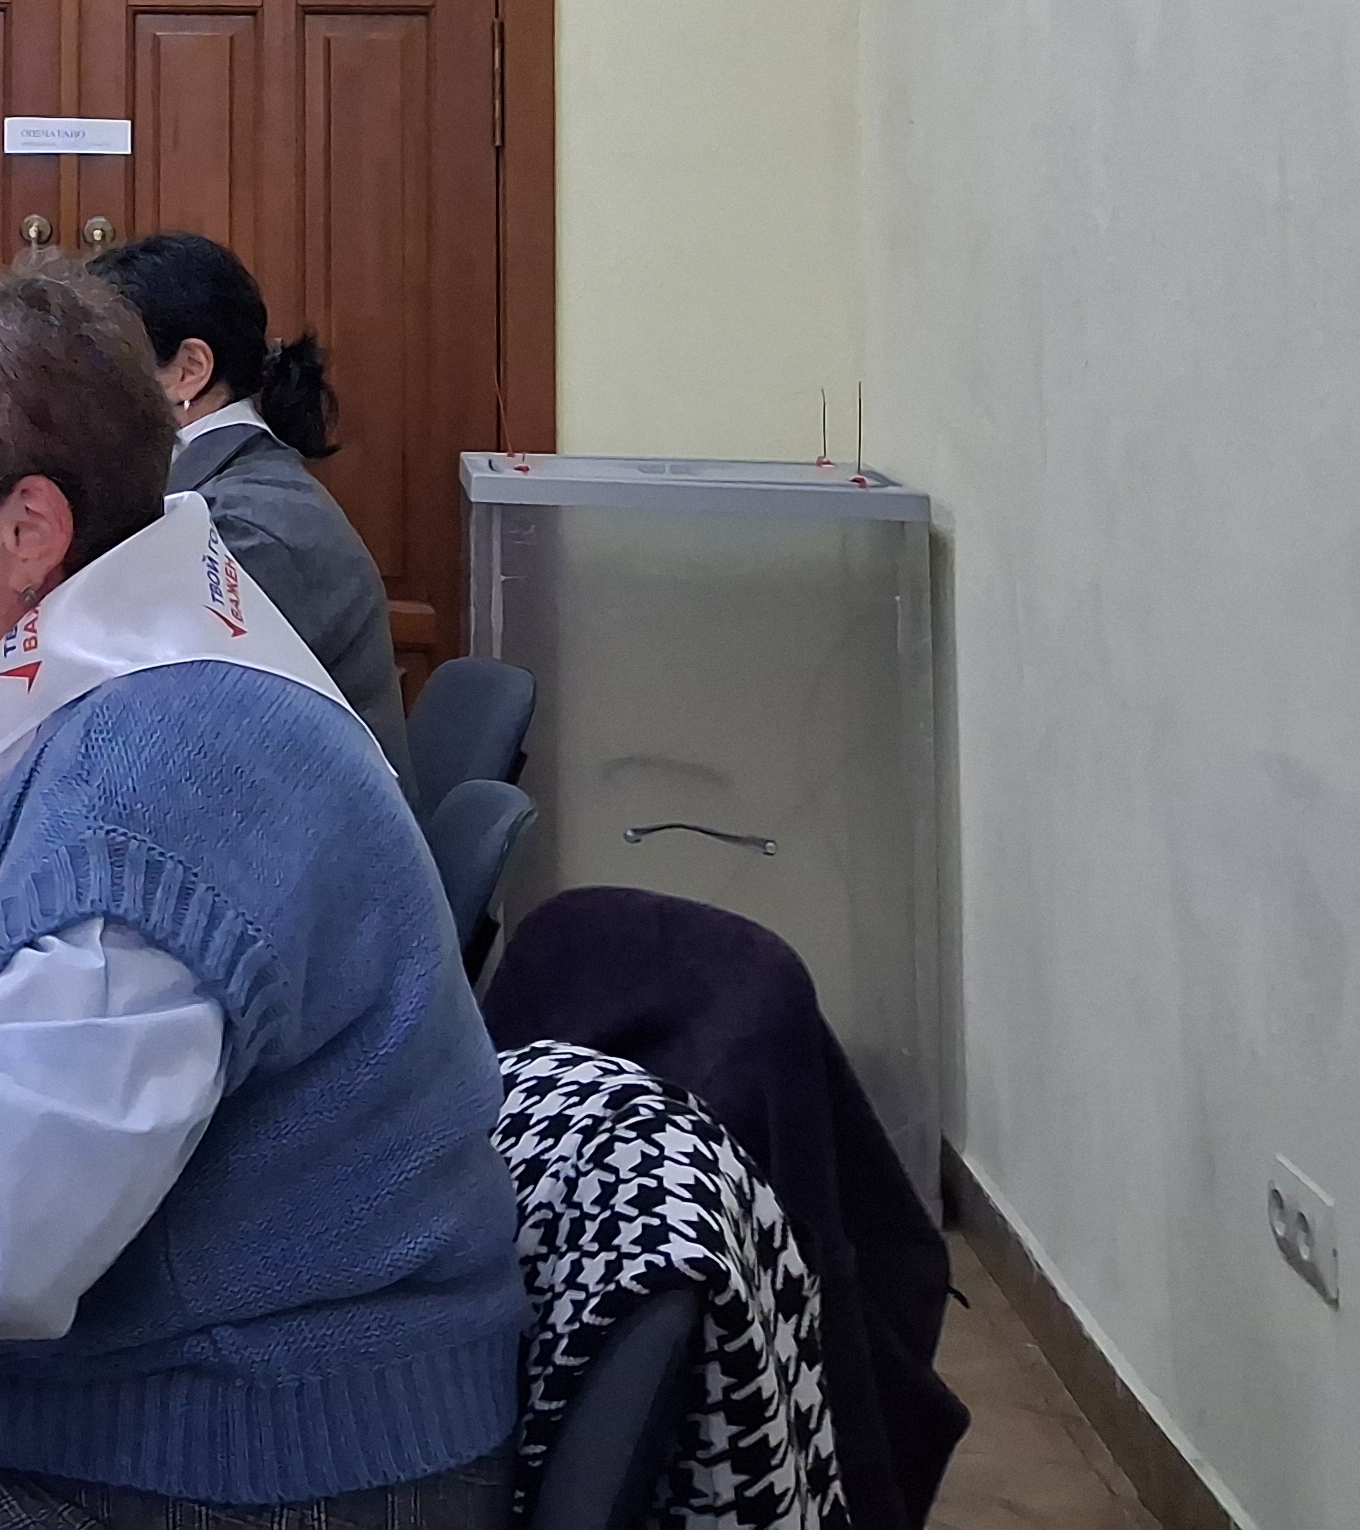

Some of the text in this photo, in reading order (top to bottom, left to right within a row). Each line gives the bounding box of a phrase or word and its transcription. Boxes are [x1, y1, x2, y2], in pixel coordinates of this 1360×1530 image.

[202, 519, 225, 606] ТВОЙ ГО
[224, 553, 244, 623] ВАЖЕН
